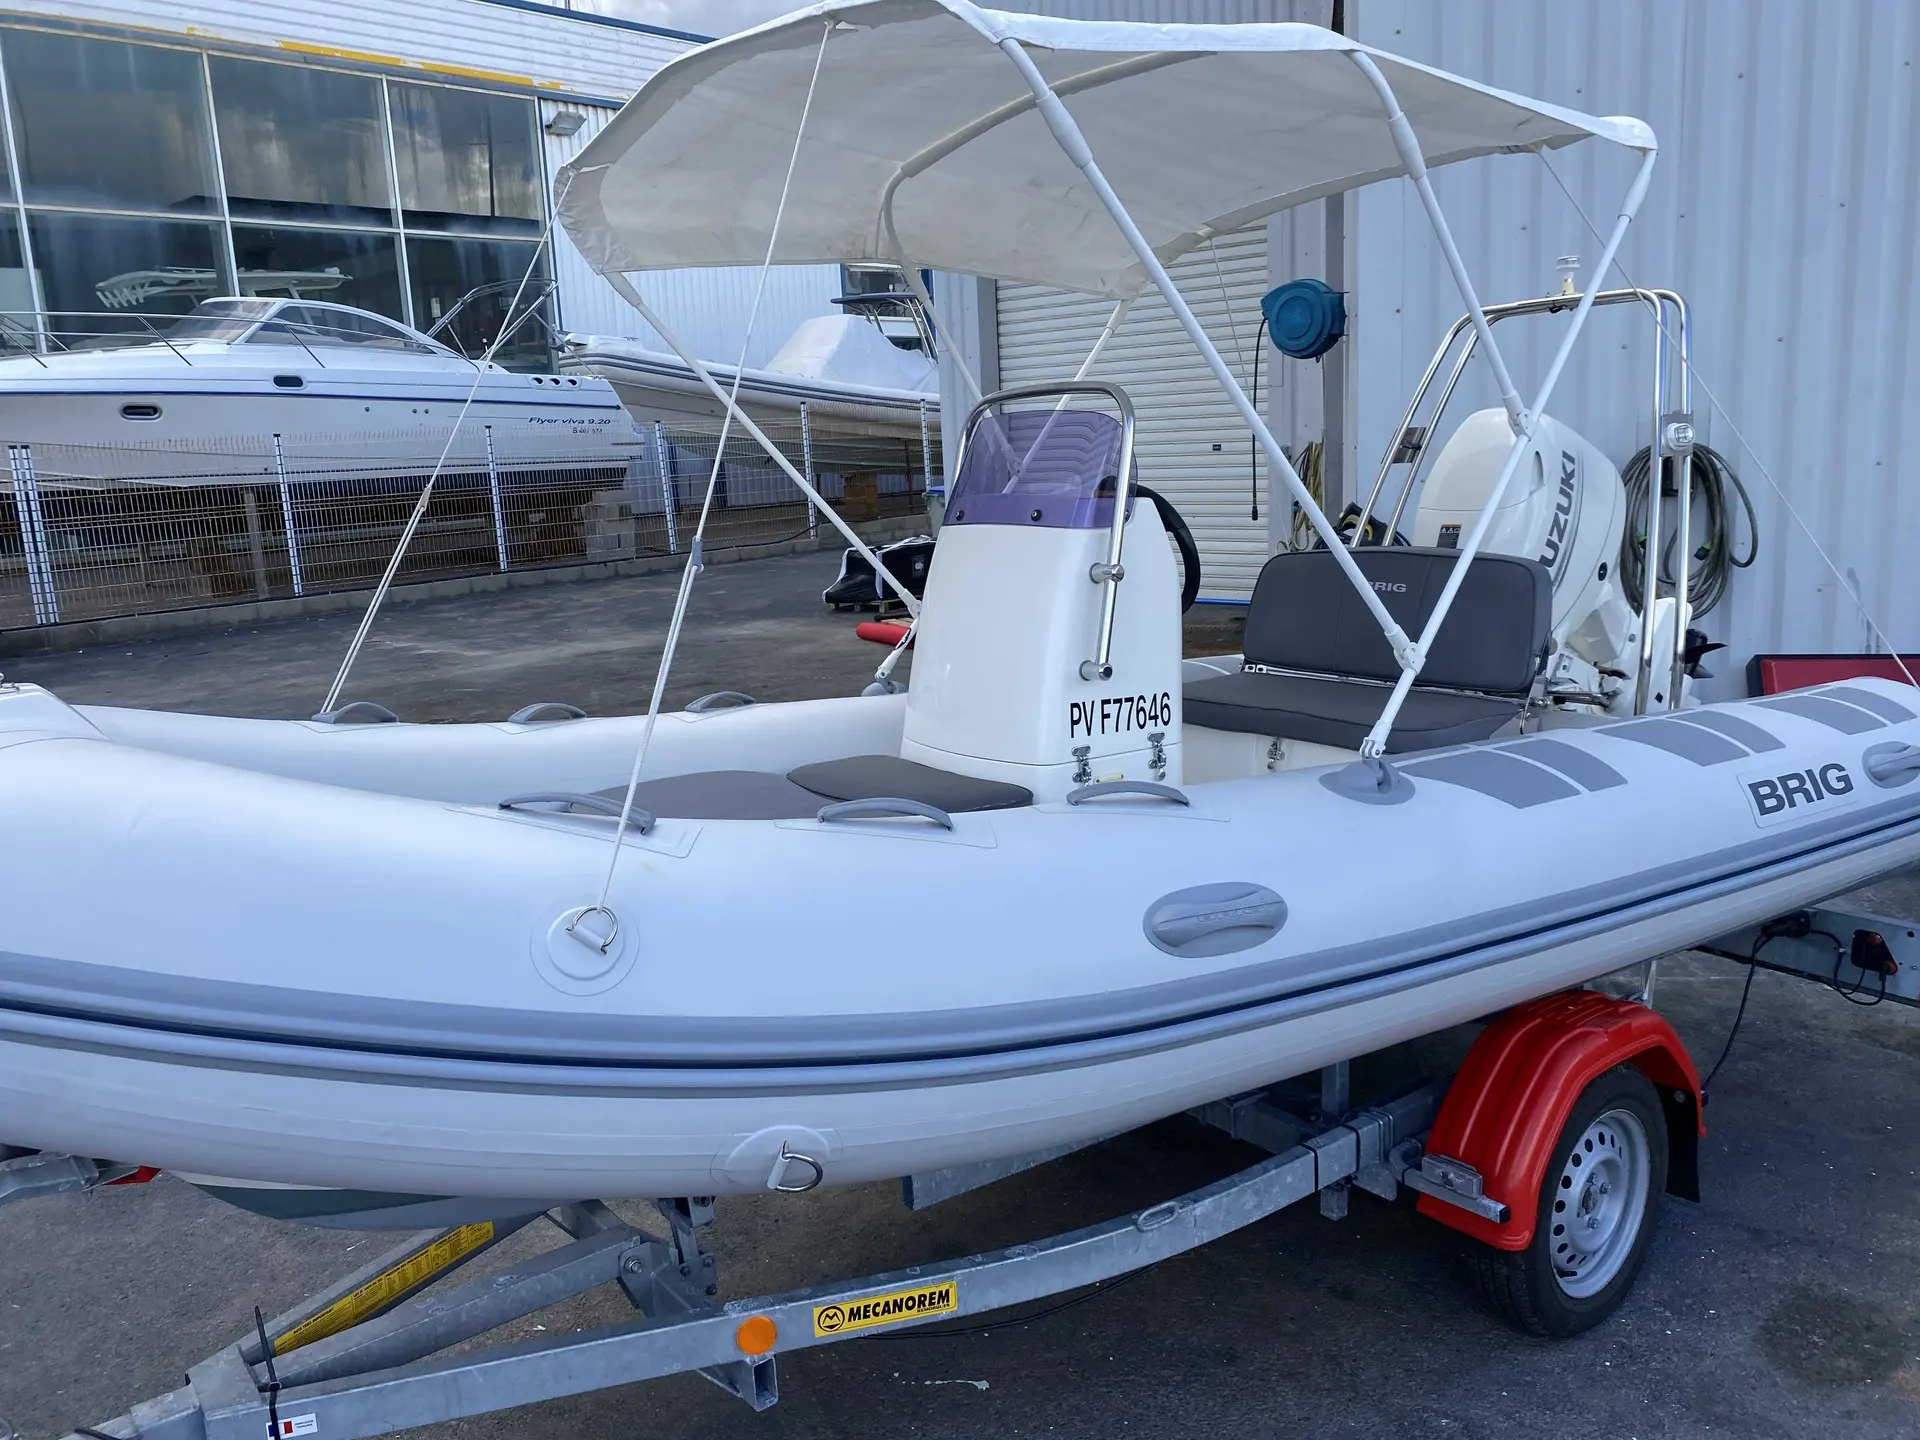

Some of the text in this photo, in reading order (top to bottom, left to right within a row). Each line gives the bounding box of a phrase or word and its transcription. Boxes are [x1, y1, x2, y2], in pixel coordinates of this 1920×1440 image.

[528, 416, 559, 425] Flyer
[1537, 449, 1576, 568] UZUKI
[1069, 691, 1171, 739] PV F77646
[1747, 762, 1855, 816] BRIG
[847, 1288, 950, 1322] MECANOREM
